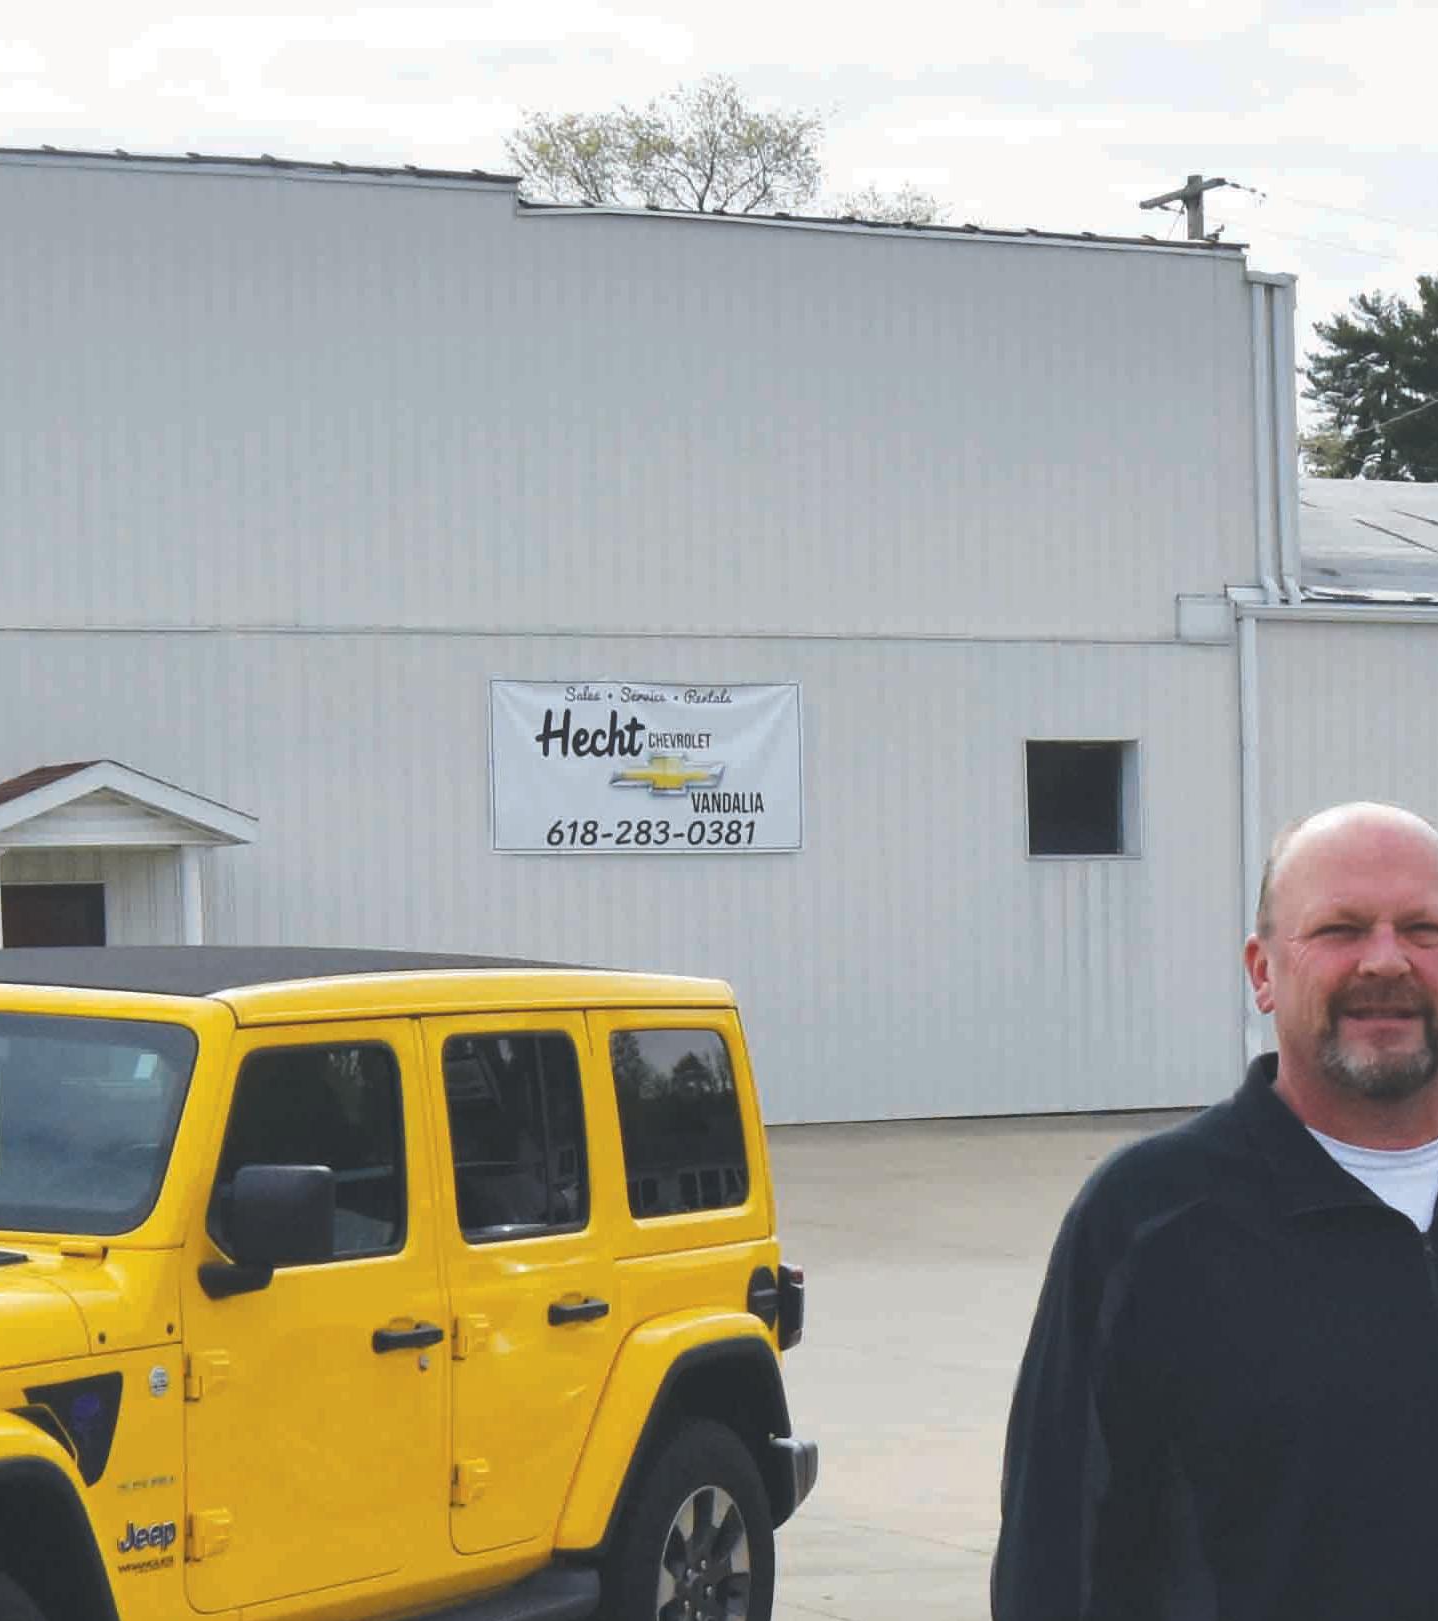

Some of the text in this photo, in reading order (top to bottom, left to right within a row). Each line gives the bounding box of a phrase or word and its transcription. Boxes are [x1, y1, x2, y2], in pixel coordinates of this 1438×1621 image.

[564, 685, 733, 704] Sales Service Rentals
[535, 708, 712, 757] Hecht CHEVROLET
[690, 791, 765, 813] VANDALIA
[545, 819, 756, 847] 618-283-0381
[117, 1520, 177, 1553] Jeep
